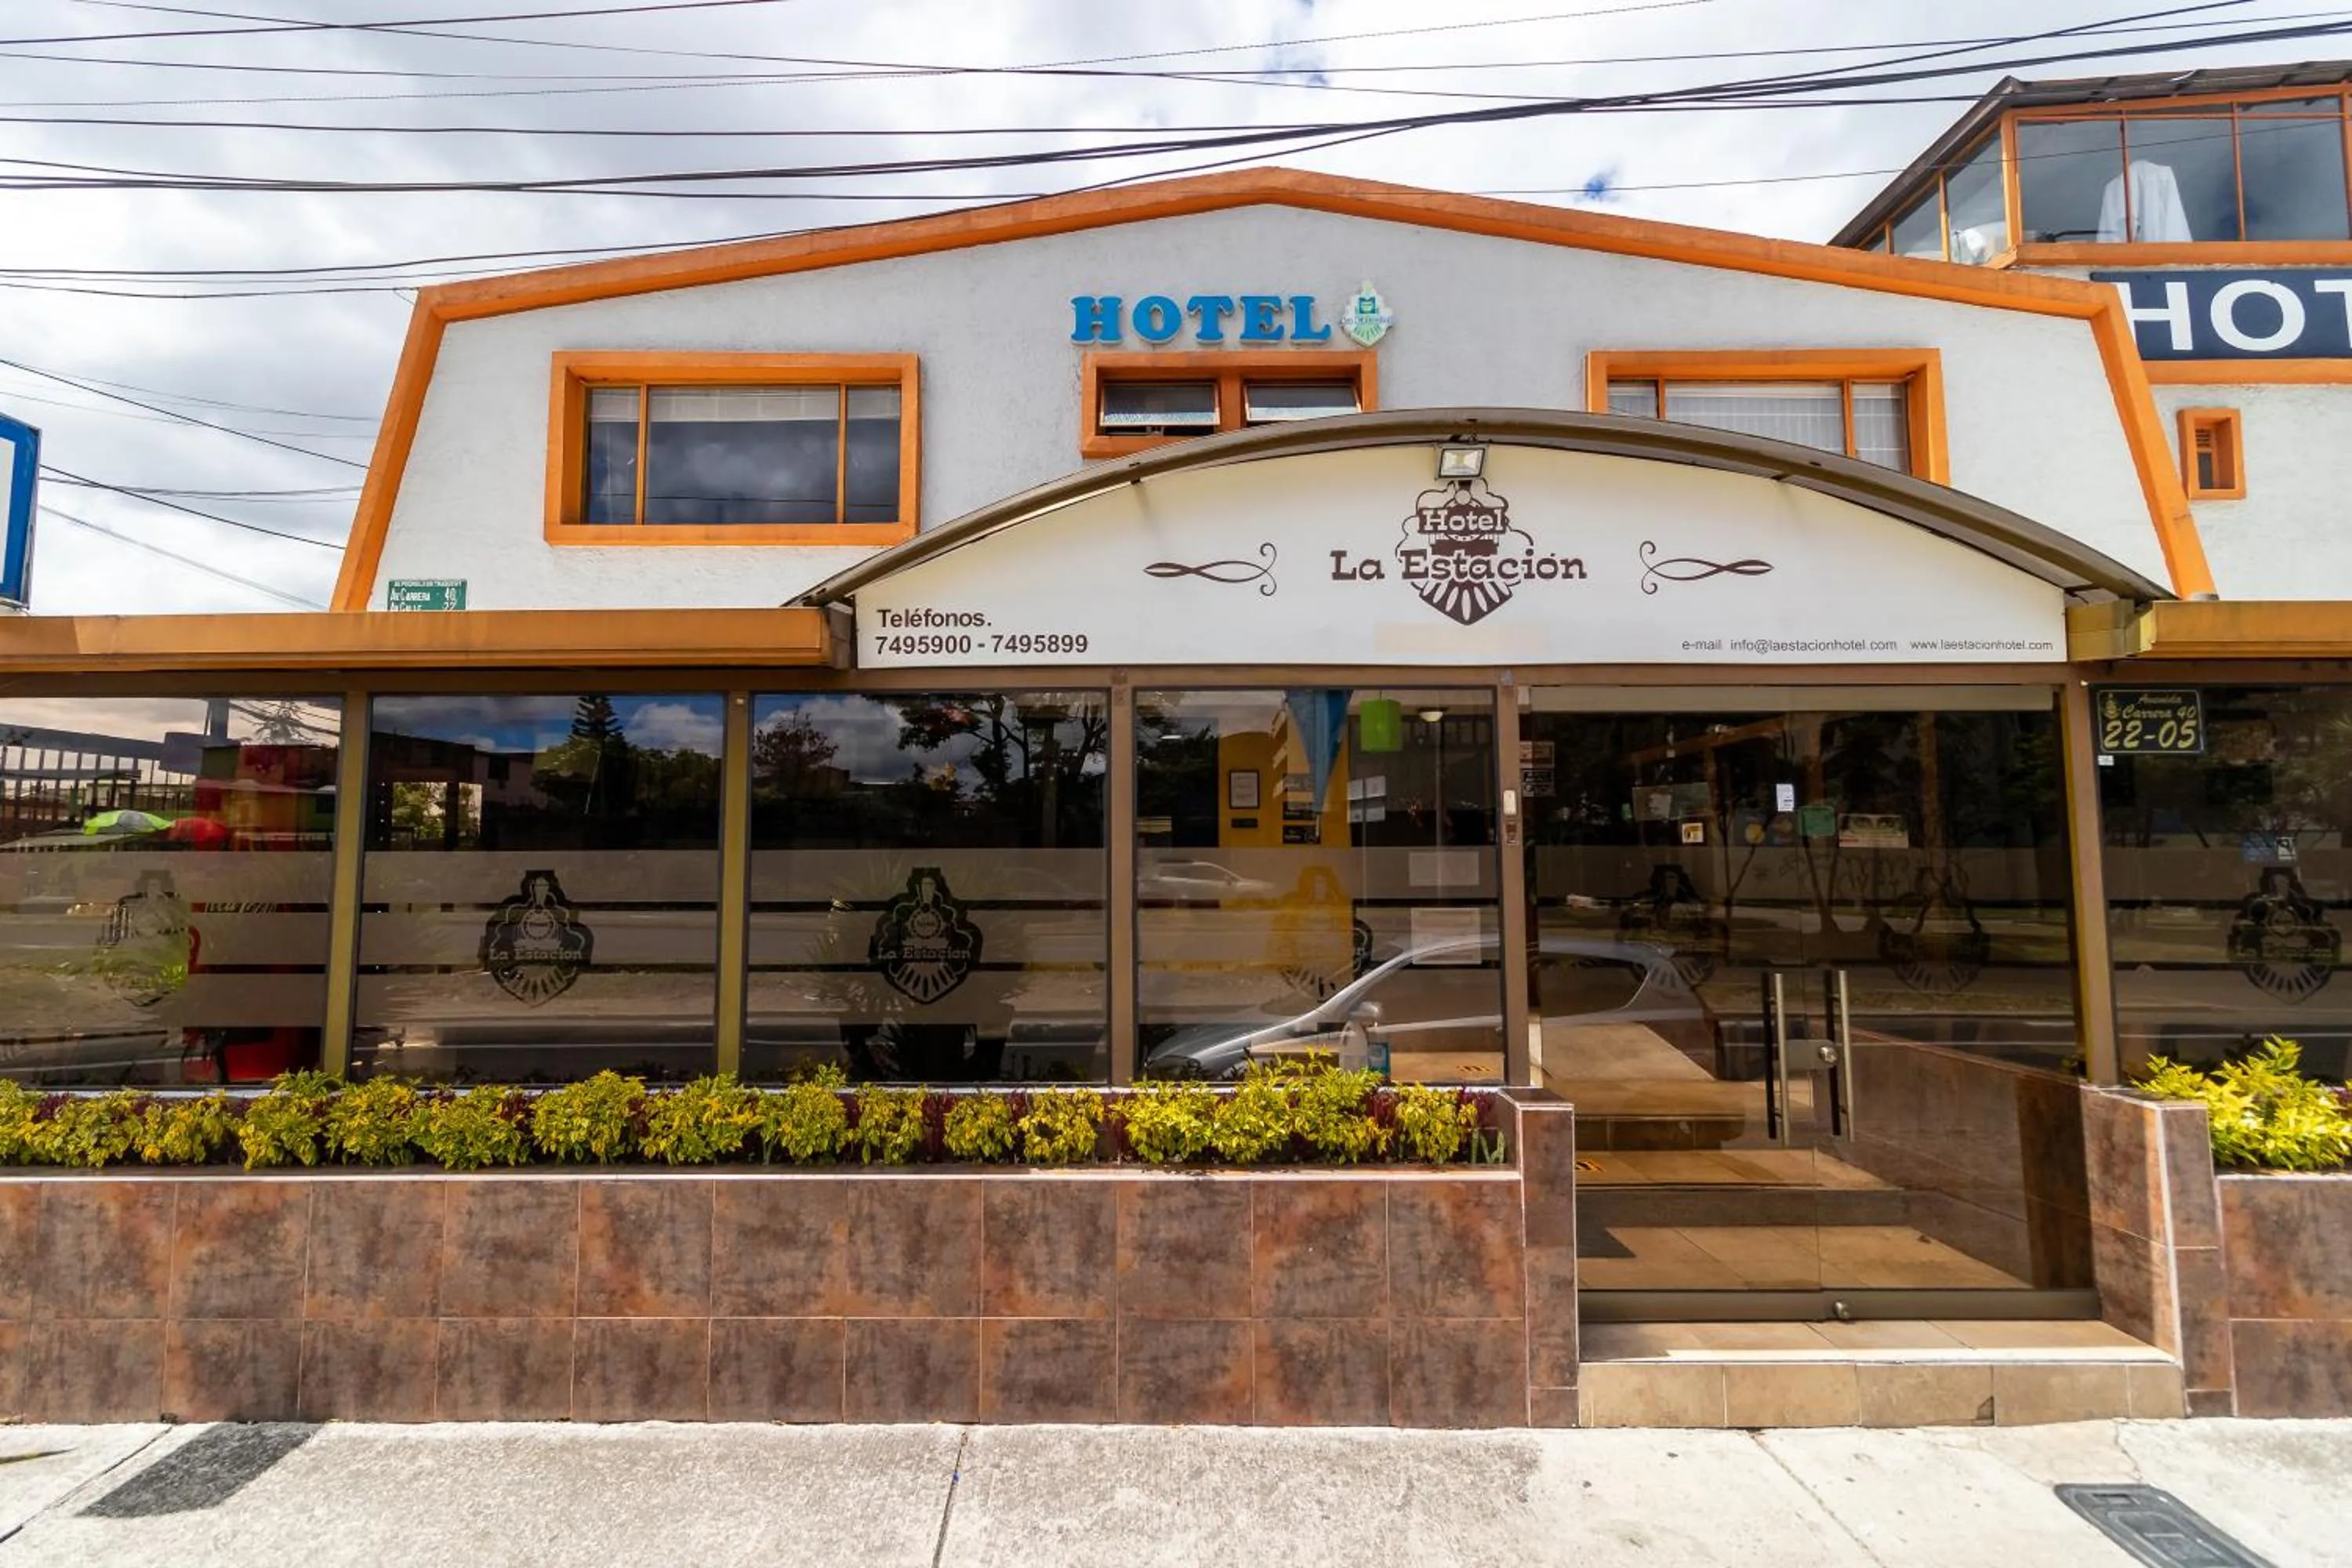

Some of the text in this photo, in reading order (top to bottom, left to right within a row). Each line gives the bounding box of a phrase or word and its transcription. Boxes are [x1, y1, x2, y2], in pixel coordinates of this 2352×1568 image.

[1071, 295, 1331, 344] HOTEL
[1424, 508, 1504, 532] Hotel
[1330, 549, 1587, 580] La Estación
[877, 608, 992, 627] Teléfonos.
[875, 635, 971, 654] 7495900
[991, 634, 1088, 653] 7495899
[1682, 639, 2053, 654] e-mail info@laestacionhotel.com www.laestacionhotel.com
[2122, 704, 2197, 719] Carrera 40
[2103, 720, 2197, 749] 22-05
